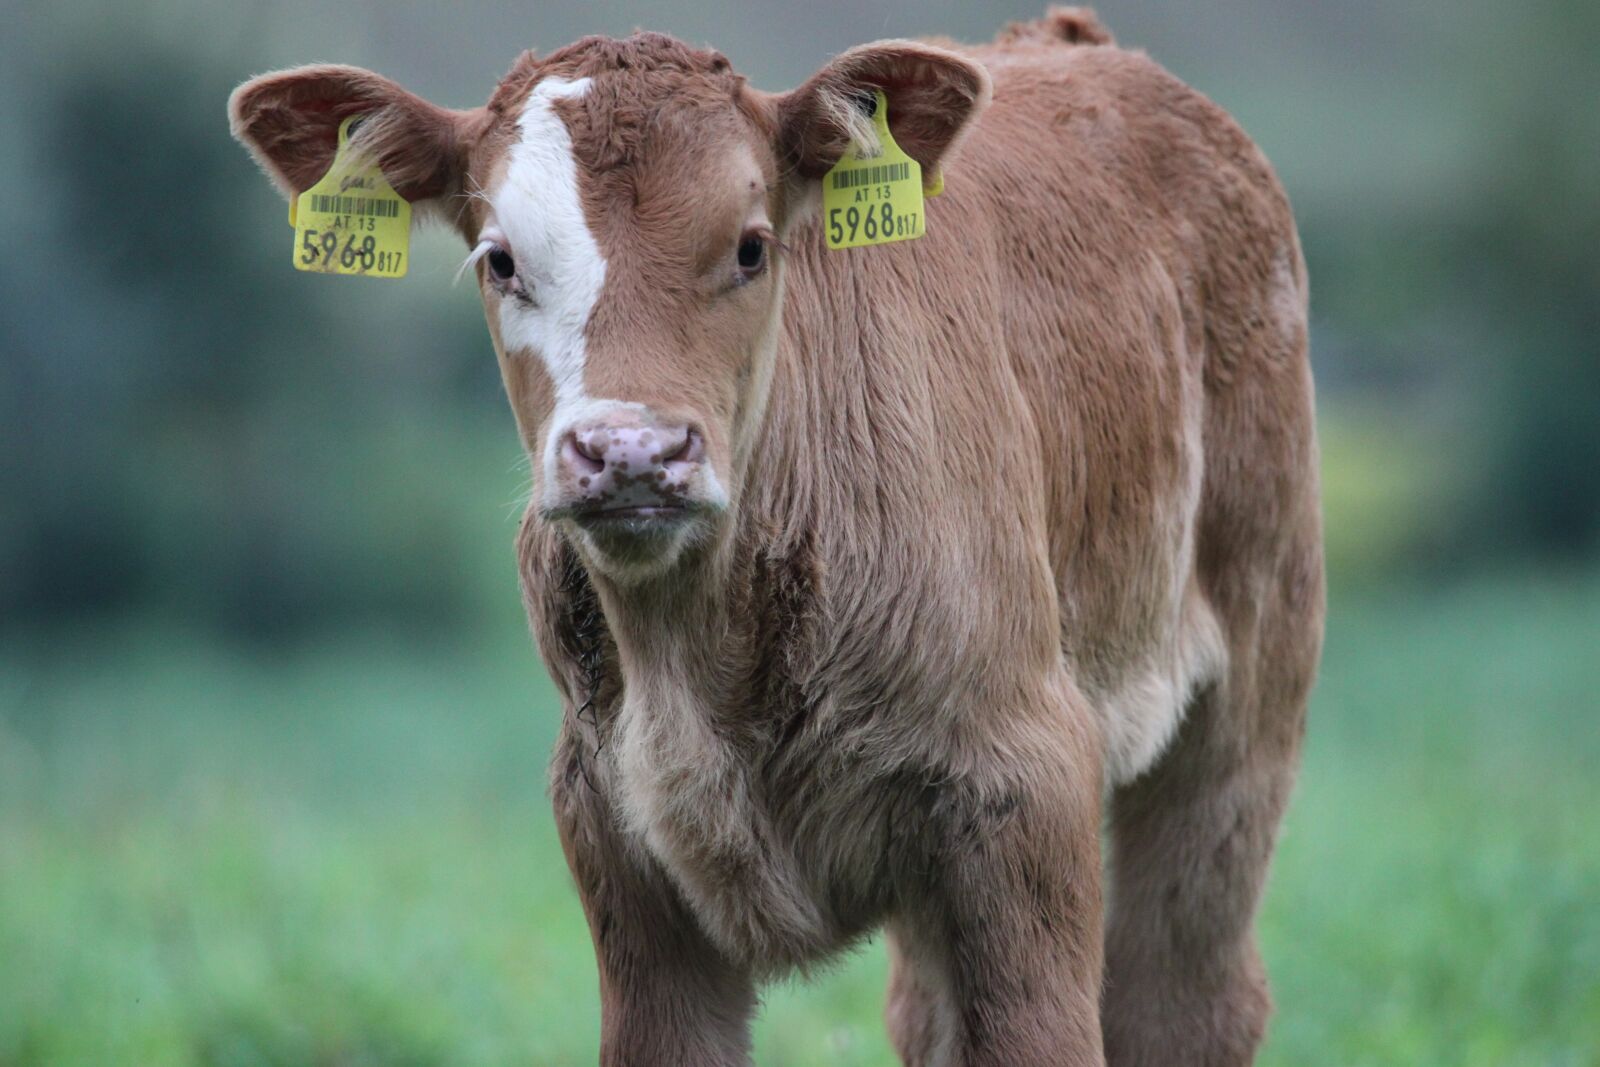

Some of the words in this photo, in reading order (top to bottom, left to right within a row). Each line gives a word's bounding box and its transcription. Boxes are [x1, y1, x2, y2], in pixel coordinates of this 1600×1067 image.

[855, 188, 869, 202] AT
[876, 185, 891, 199] 13
[334, 215, 351, 228] AT
[359, 218, 375, 231] 13
[830, 202, 894, 244] 5968
[897, 213, 917, 236] 817
[301, 229, 375, 270] 5968
[378, 251, 402, 273] 817
